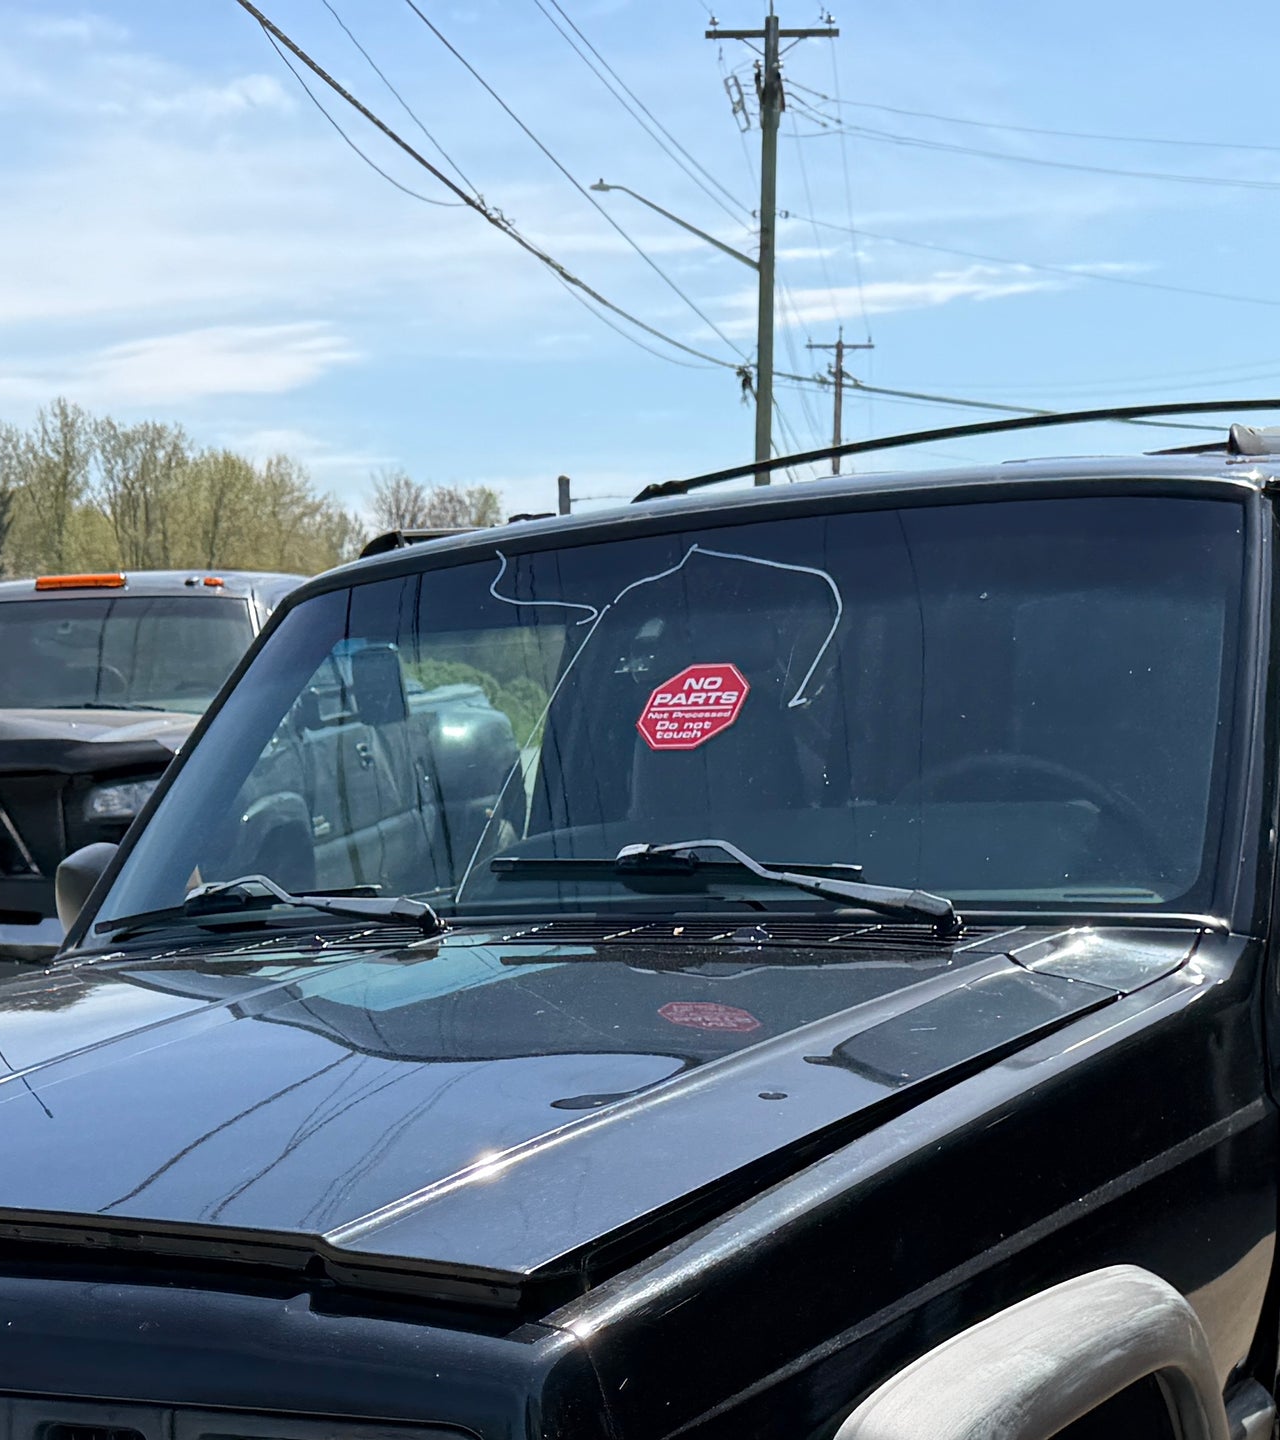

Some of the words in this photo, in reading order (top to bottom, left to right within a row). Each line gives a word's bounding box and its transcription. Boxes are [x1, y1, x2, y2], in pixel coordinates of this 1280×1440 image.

[683, 677, 723, 690] NO
[653, 691, 738, 706] PARTS
[647, 712, 669, 720] Not
[672, 711, 731, 719] Processed
[655, 720, 679, 731] Do
[683, 721, 712, 730] not
[655, 730, 702, 739] touch
